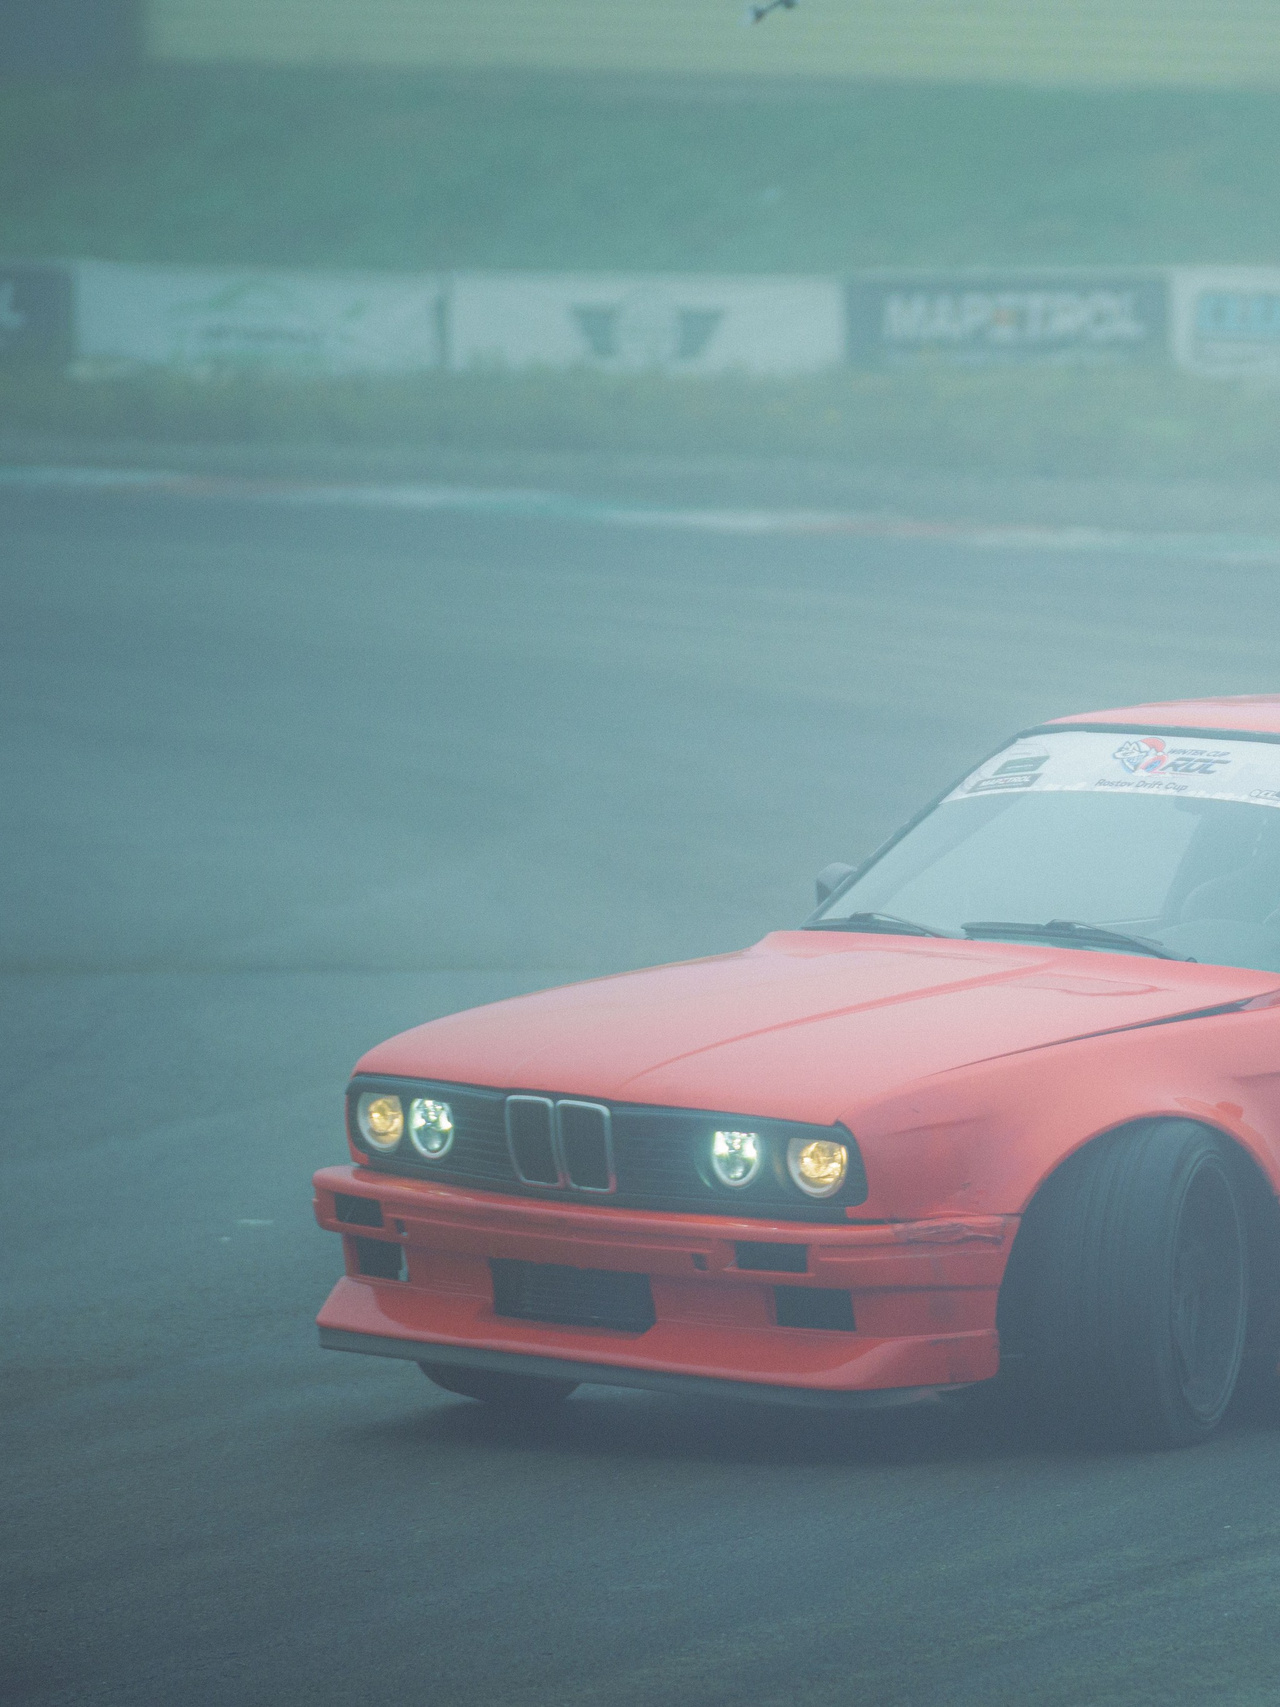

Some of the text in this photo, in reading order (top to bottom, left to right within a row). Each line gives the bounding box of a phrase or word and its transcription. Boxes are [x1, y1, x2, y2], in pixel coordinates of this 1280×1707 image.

[1094, 779, 1189, 793] Rostov Drift Cup
